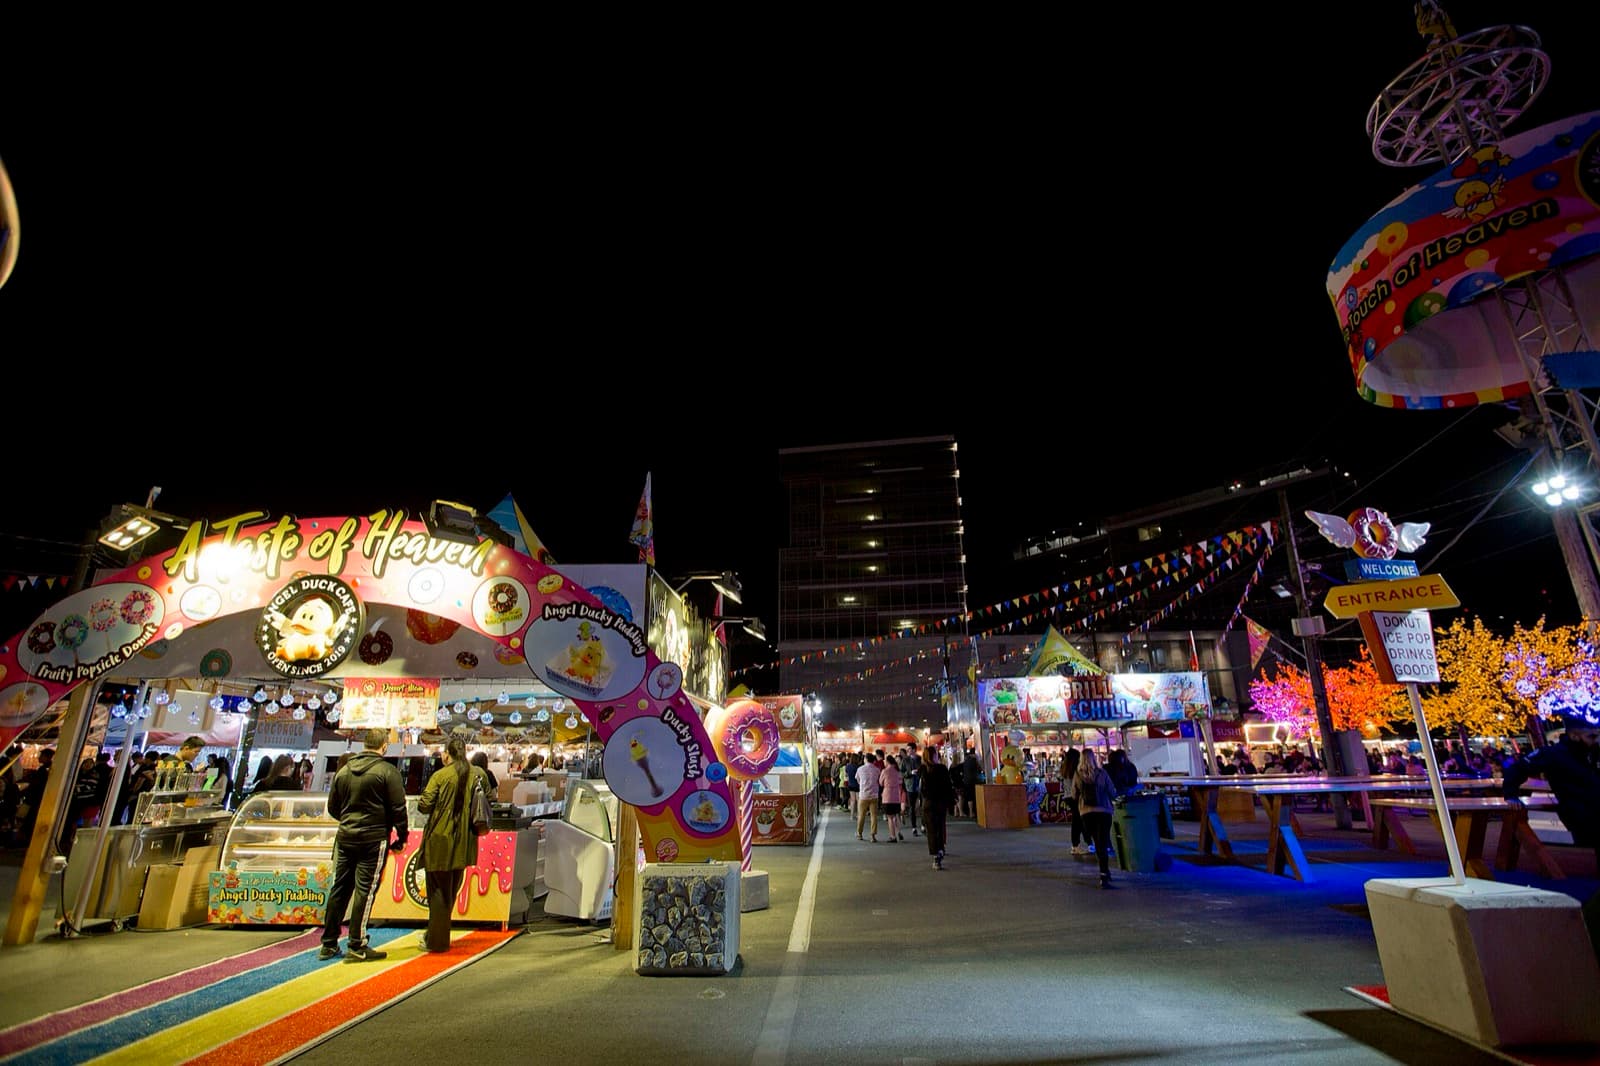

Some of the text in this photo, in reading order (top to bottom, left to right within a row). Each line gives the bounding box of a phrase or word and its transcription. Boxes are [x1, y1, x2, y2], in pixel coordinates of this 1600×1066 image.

[1348, 200, 1552, 331] Touch of Heaven
[164, 509, 494, 583] A Taste of Heaven
[1361, 562, 1417, 577] WELCOME
[264, 579, 356, 622] ANGEL DUCK CAFE
[1337, 583, 1443, 608] ENTRANCE
[544, 604, 576, 620] Angel
[580, 604, 613, 627] Ducky
[613, 617, 646, 655] Pudding
[1383, 616, 1421, 629] DONUT
[1383, 632, 1431, 644] ICE POP
[38, 625, 157, 683] Fruity Popsicle Donut
[267, 645, 346, 676] OPEN SINCE 2019
[1389, 647, 1434, 660] DRINKS
[1394, 663, 1436, 677] GOODS
[1060, 681, 1113, 699] GRILL
[1078, 699, 1133, 719] CHILL
[663, 709, 701, 778] Ducky Slush
[219, 888, 325, 906] Angel Ducky Pudding
